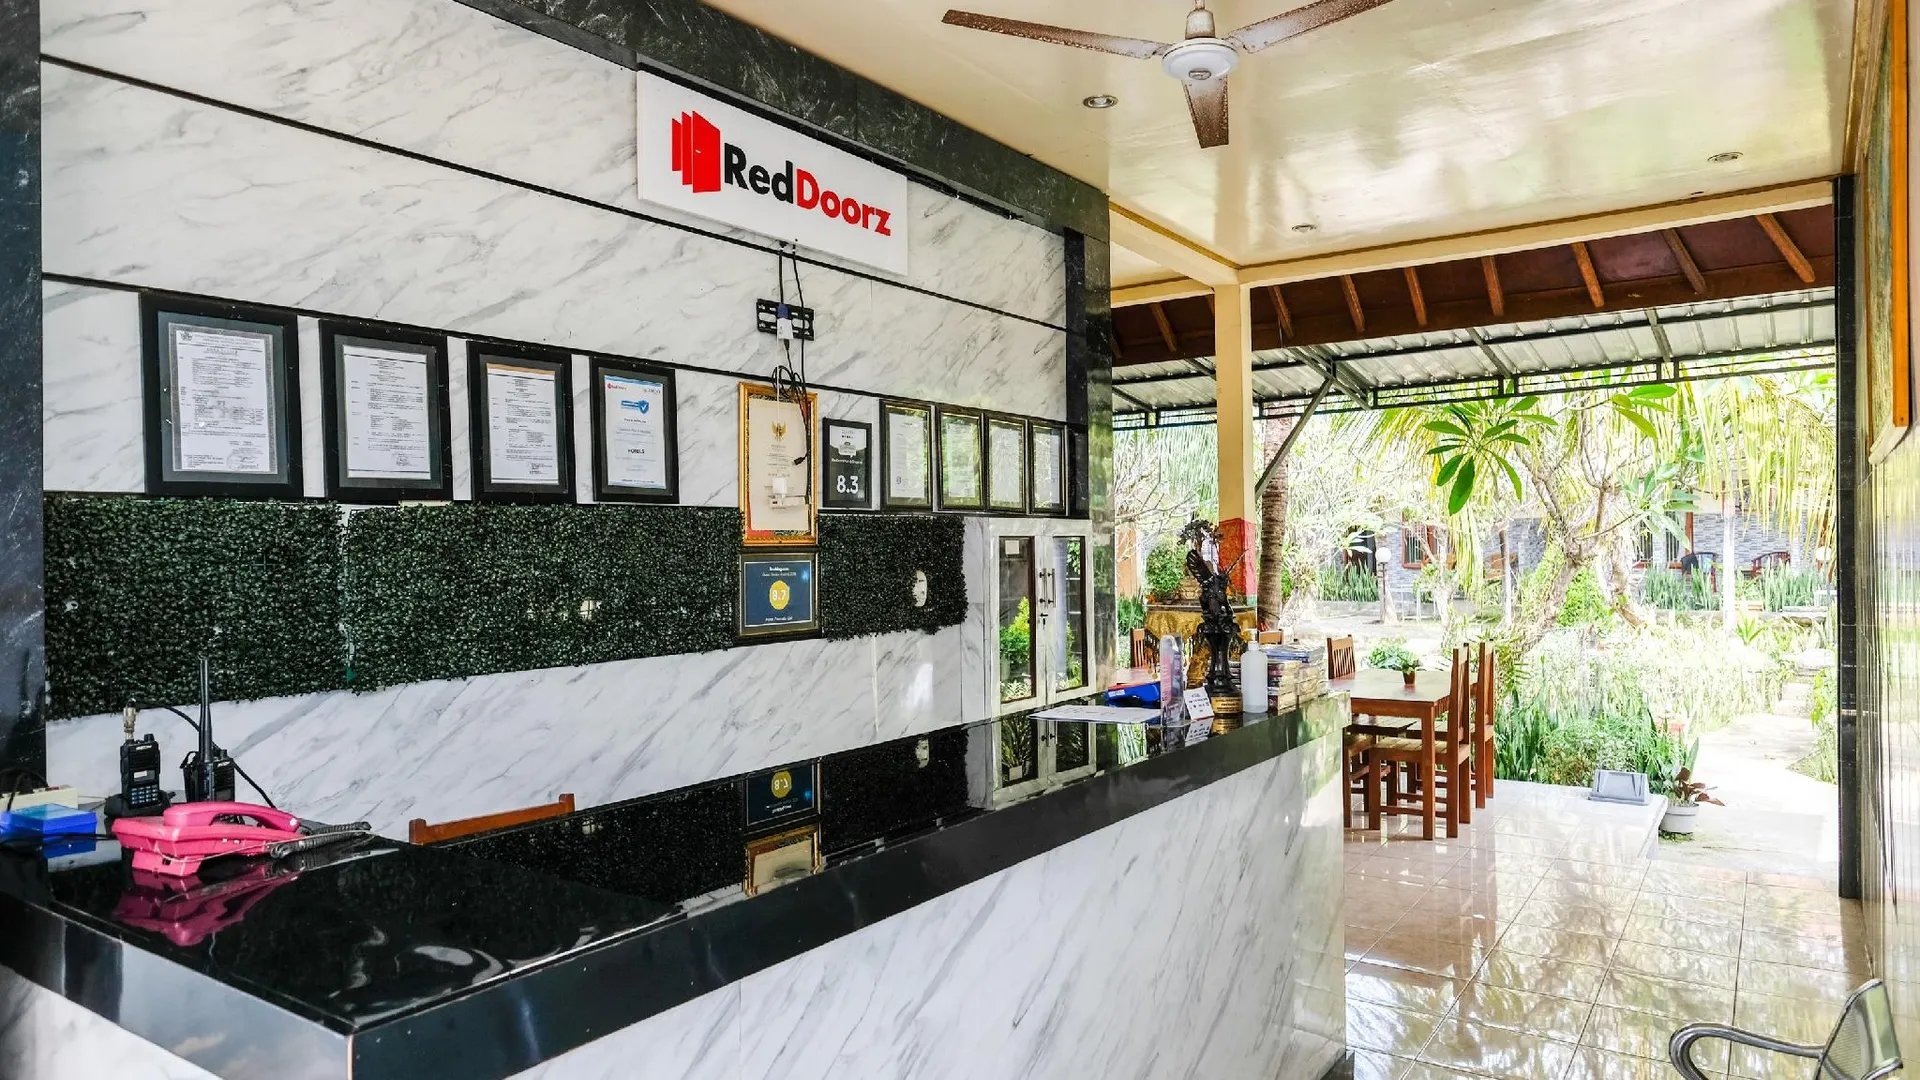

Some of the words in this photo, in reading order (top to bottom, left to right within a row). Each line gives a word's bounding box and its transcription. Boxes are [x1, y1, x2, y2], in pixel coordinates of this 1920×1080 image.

[724, 143, 891, 236] RedDoorz
[836, 474, 859, 494] 8.3
[772, 590, 787, 601] 8.7
